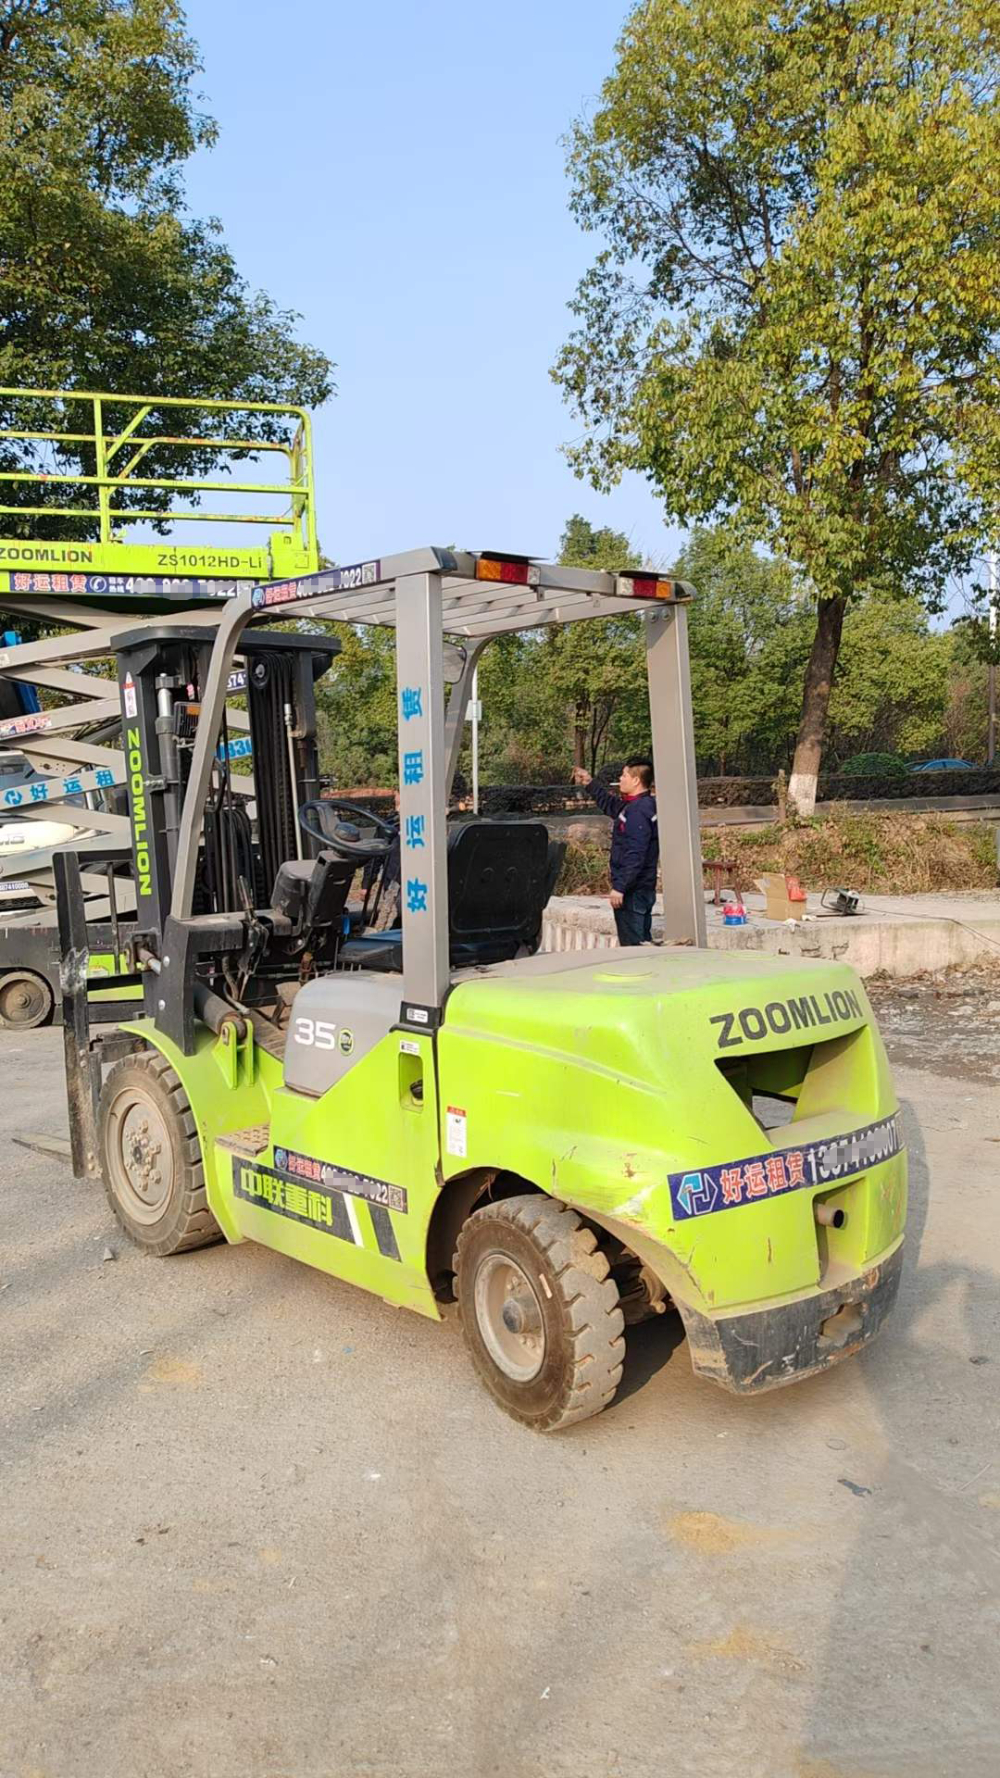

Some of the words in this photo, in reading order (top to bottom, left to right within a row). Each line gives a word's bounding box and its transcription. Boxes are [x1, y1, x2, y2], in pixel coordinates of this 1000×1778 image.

[14, 572, 87, 593] 好运租赁
[157, 554, 262, 569] ZS1012HD-Li
[127, 727, 152, 896] ZOOMLION
[294, 1017, 336, 1050] 35
[710, 989, 863, 1049] ZOOMLION
[240, 1166, 333, 1227] 中联重科
[719, 1151, 806, 1204] 好运租赁
